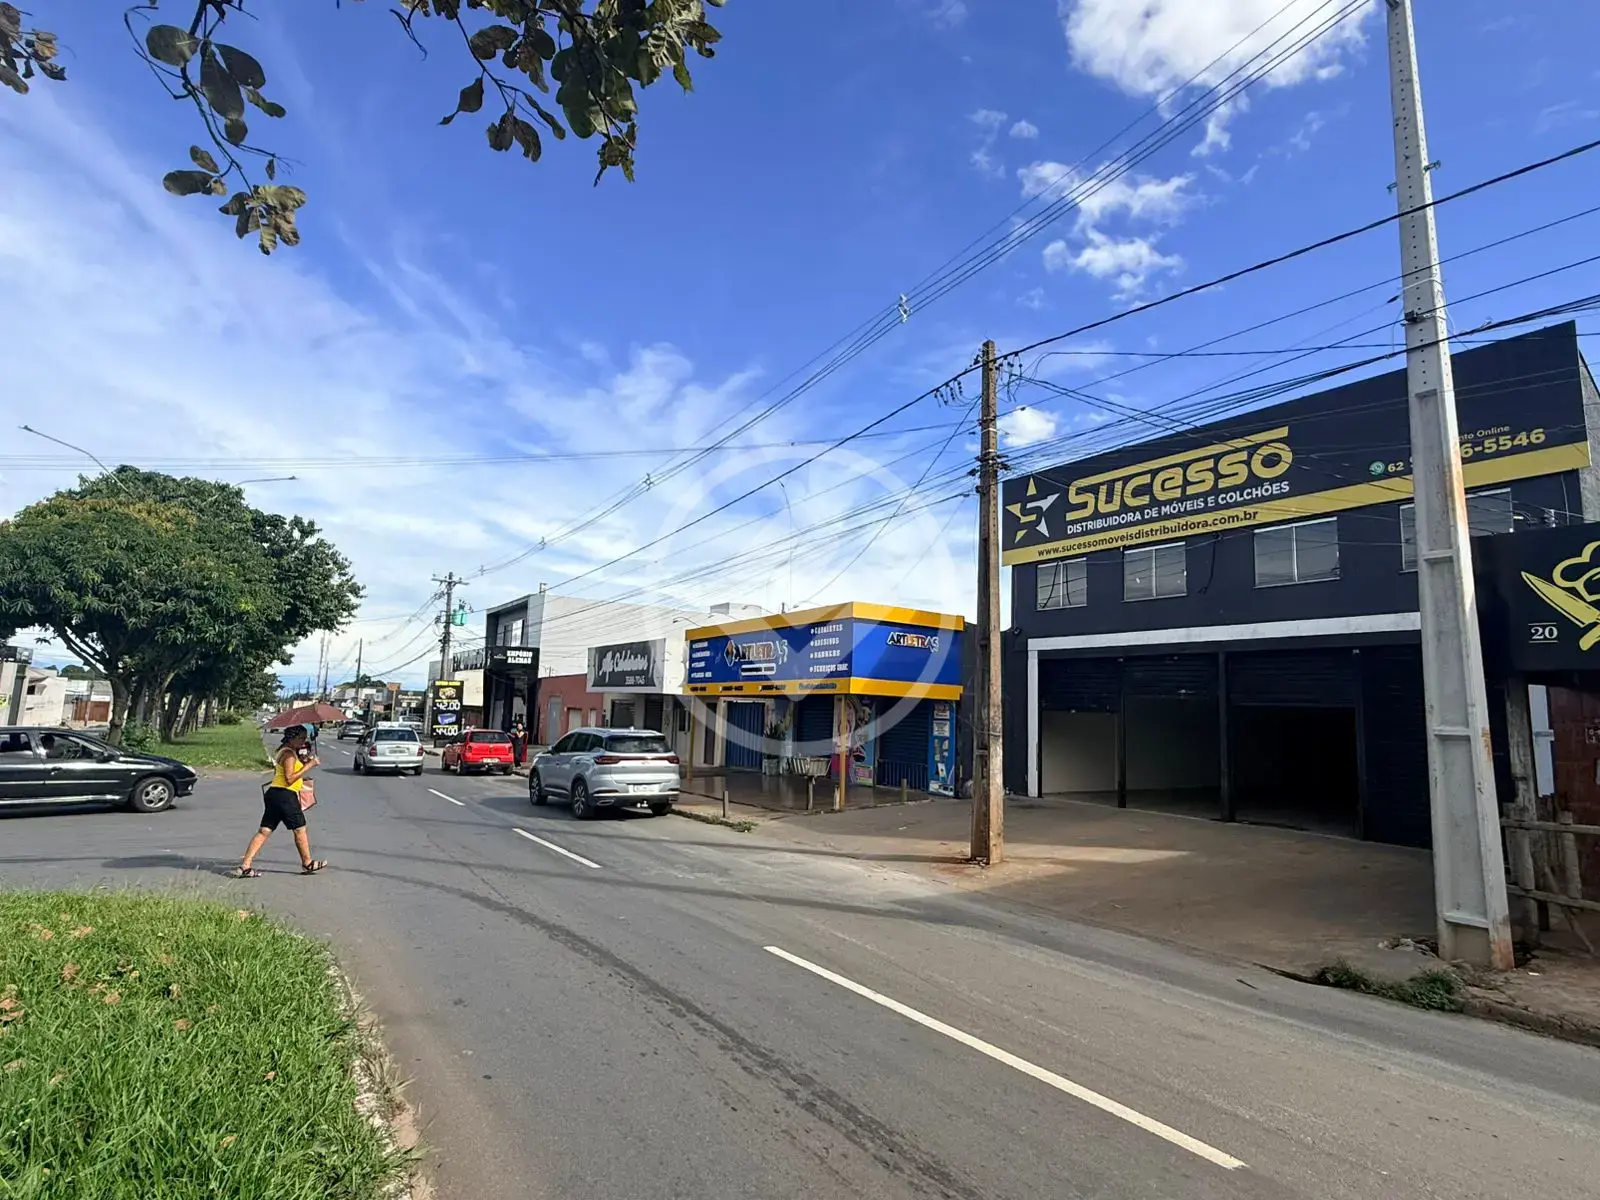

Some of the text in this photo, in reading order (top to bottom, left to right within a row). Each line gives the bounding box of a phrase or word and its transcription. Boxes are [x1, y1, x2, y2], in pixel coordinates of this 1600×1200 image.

[1477, 425, 1510, 437] Online
[1387, 429, 1546, 473] 62 6-5546
[1067, 480, 1290, 535] DISTRIBUIDORA DE MÓVEIS E COLCHÕES
[1037, 510, 1259, 557] www.sucessomoveisdistribuidora.com.br
[887, 631, 939, 653] ARTLETRAS
[1531, 626, 1558, 639] 20
